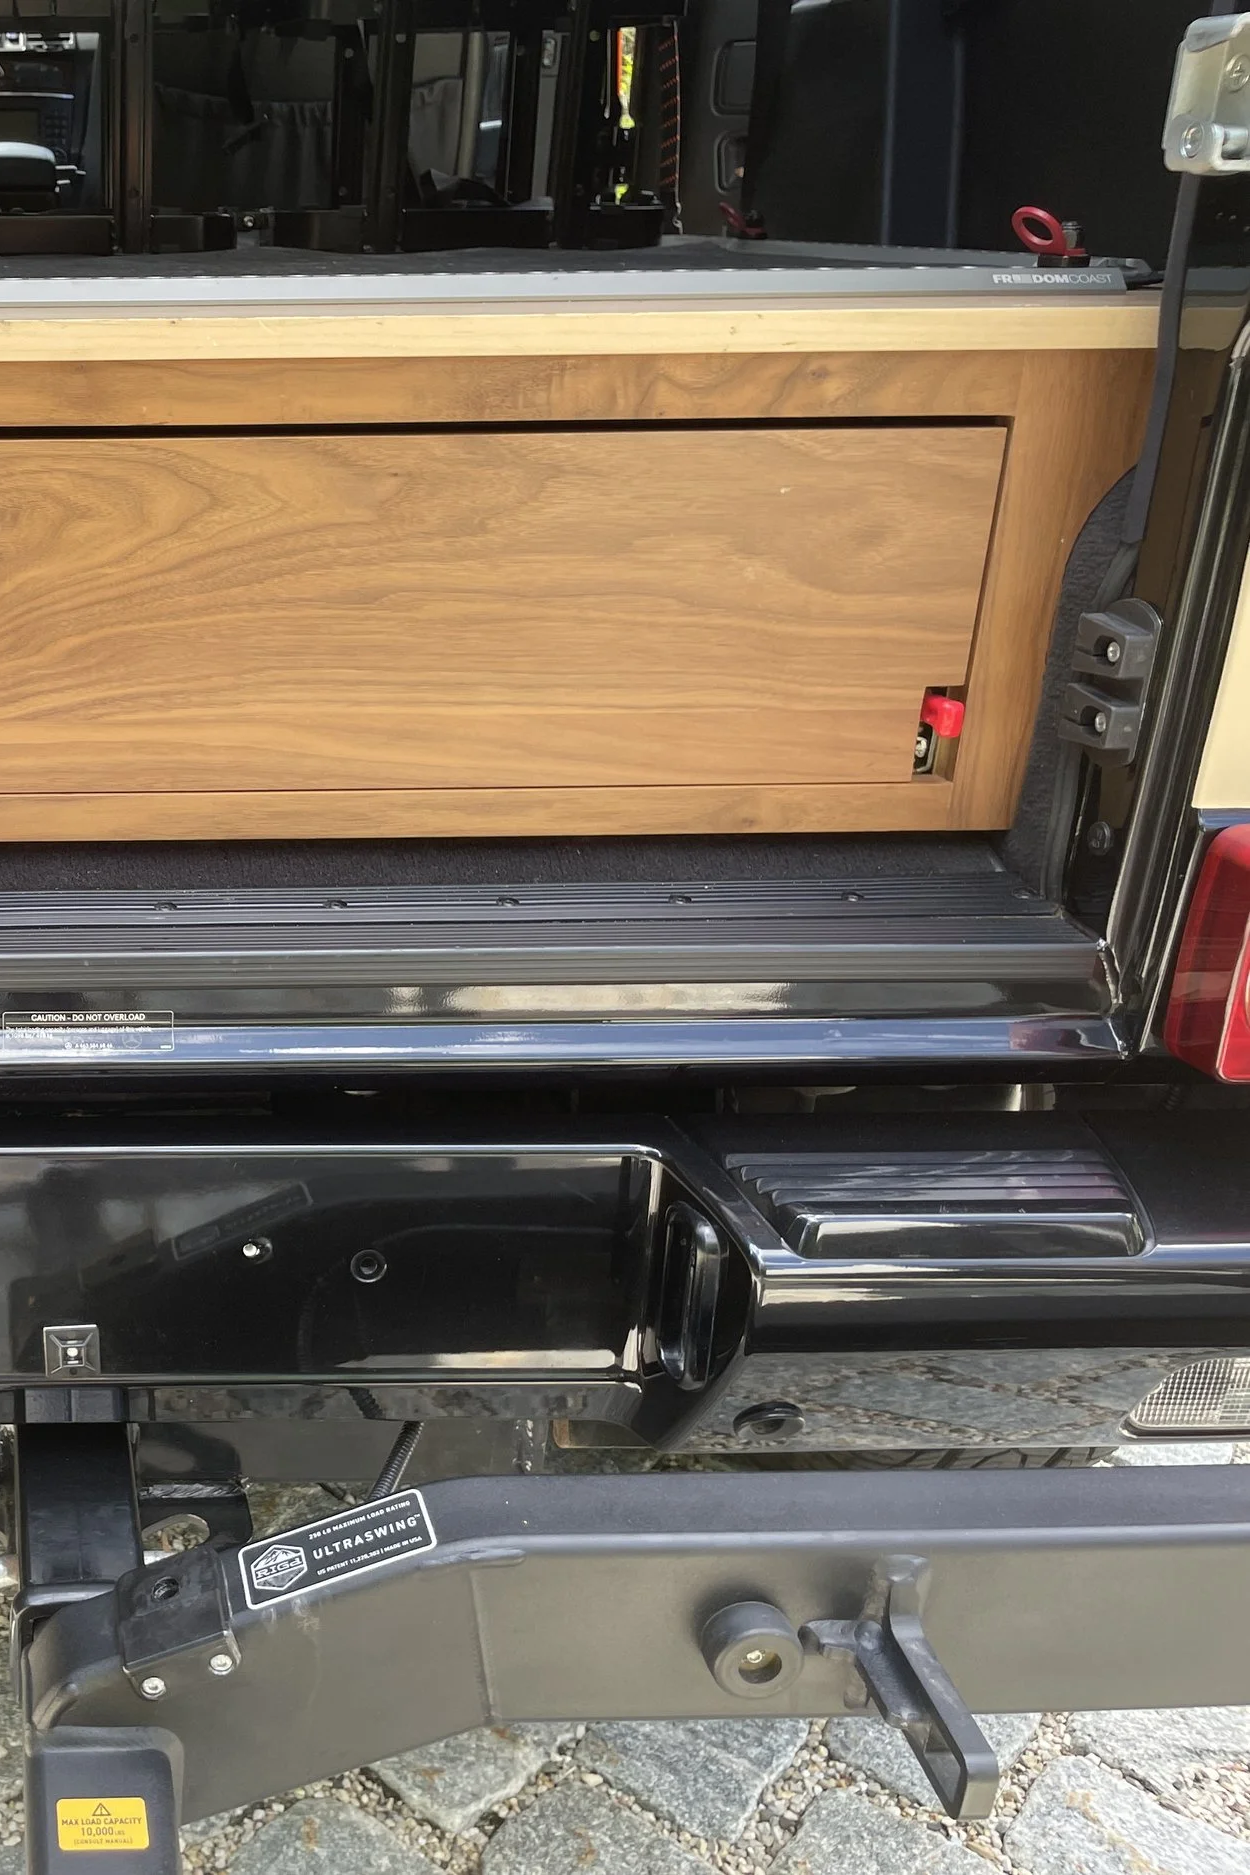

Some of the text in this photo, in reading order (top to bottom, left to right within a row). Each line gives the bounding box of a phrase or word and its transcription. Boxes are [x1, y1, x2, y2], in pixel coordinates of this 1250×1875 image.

[31, 1014, 66, 1022] CAUTION
[86, 1013, 102, 1021] NOT
[103, 1013, 146, 1021] OVERLOAD
[332, 1516, 366, 1532] MAXIMUM
[366, 1509, 385, 1519] LOAD
[385, 1500, 411, 1513] RATING
[384, 1543, 401, 1552] MADE
[409, 1536, 423, 1544] USA
[103, 1817, 142, 1825] CAPACITY
[81, 1827, 114, 1837] 10,000
